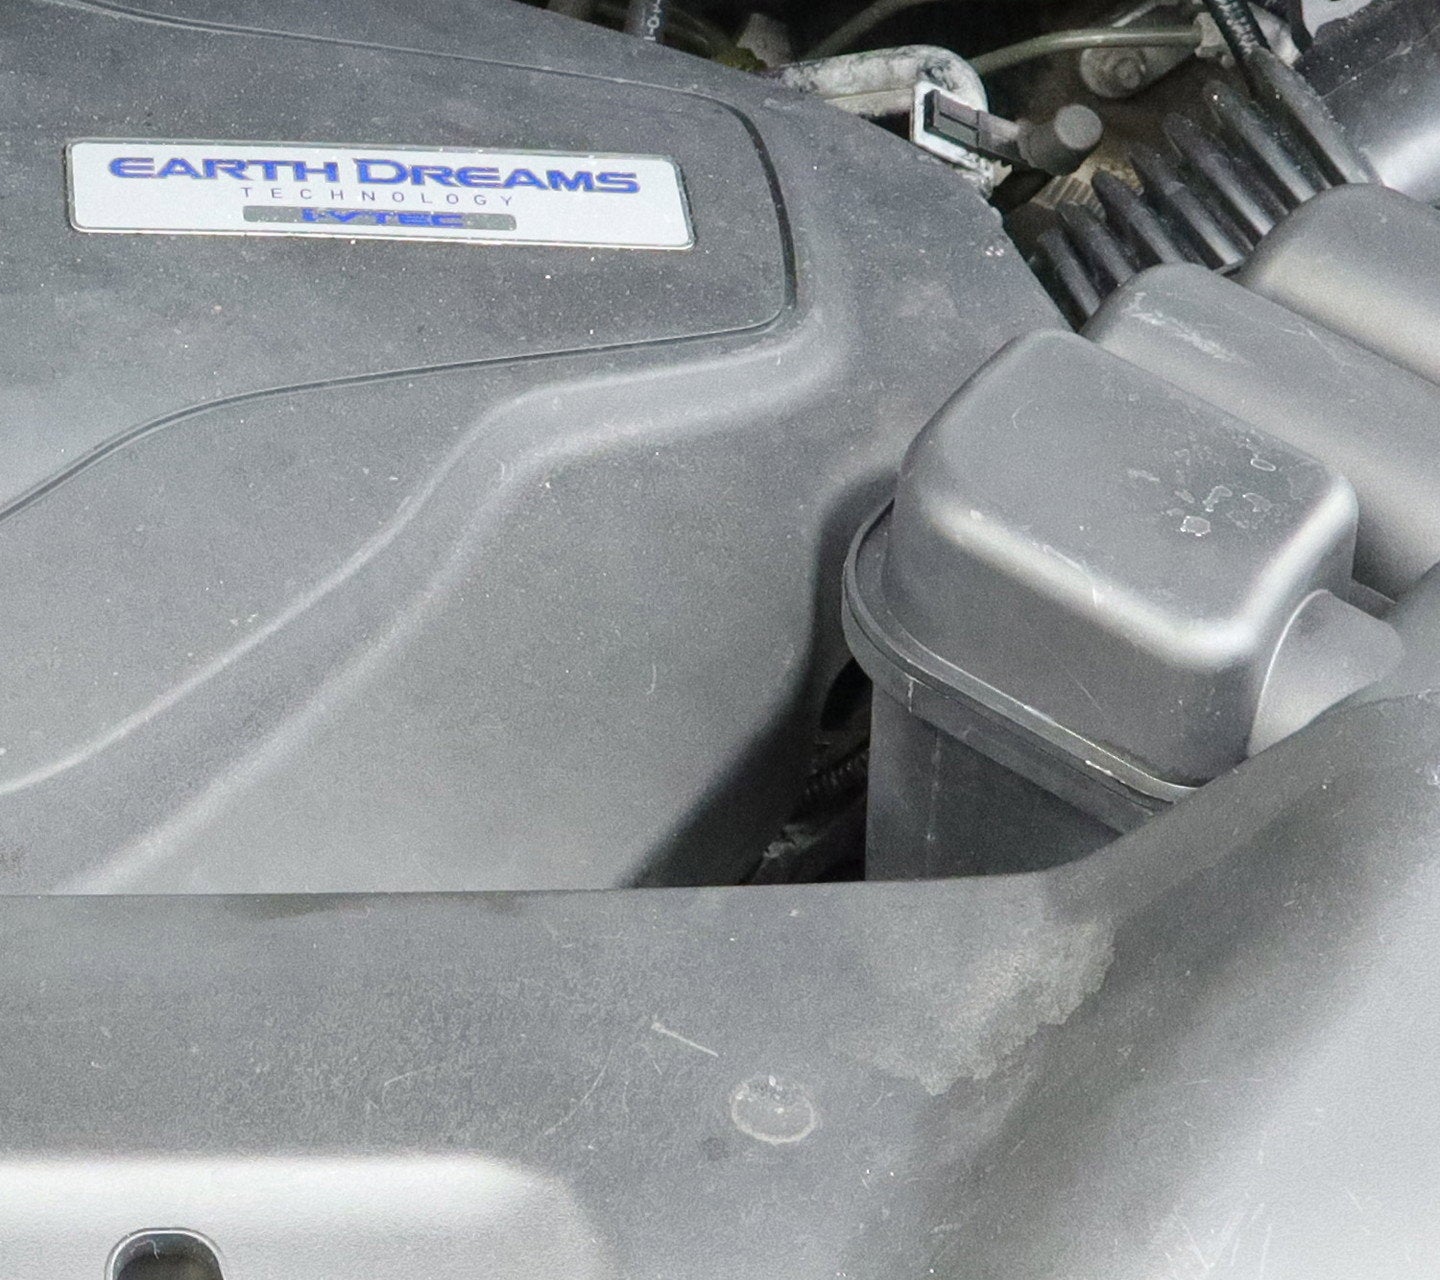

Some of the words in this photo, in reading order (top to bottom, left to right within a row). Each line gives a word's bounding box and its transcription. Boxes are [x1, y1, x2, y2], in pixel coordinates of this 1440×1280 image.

[108, 156, 341, 184] EARTH
[352, 156, 642, 195] DREAMS
[241, 185, 516, 208] TECHNOLOGY
